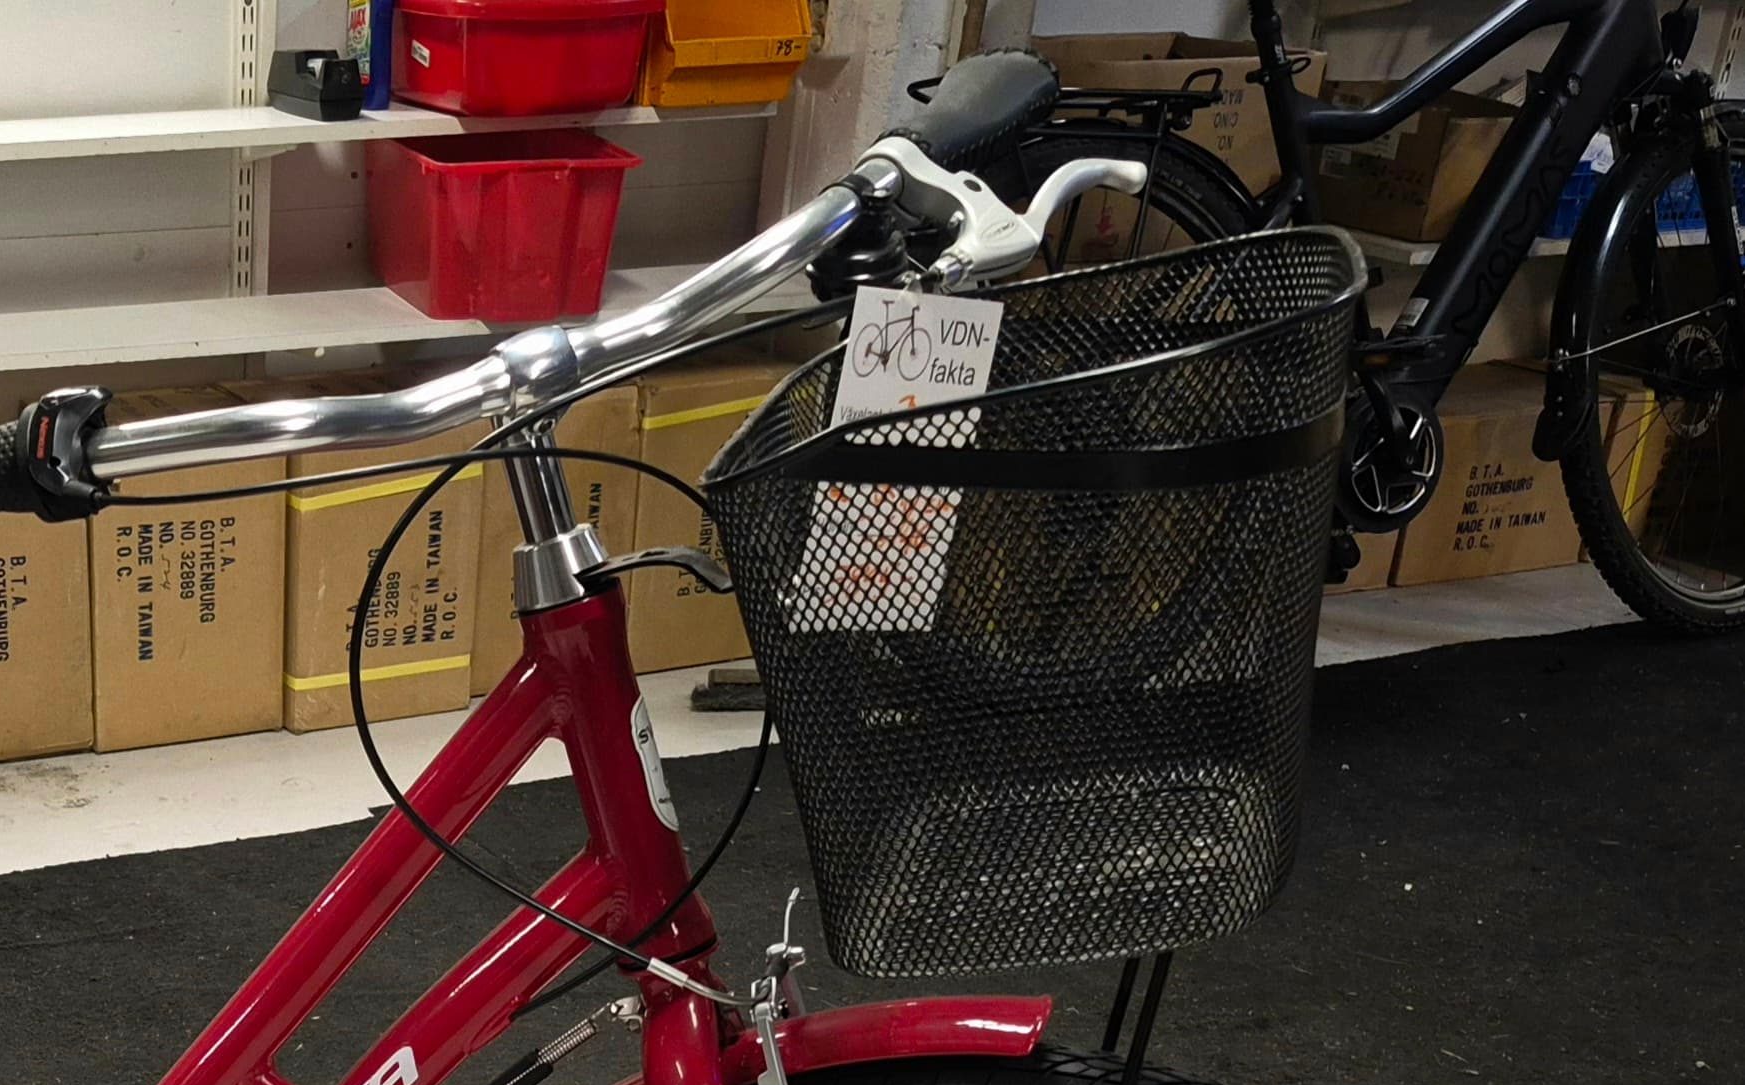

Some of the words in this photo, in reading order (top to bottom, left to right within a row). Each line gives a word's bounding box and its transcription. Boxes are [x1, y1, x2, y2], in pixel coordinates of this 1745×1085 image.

[940, 318, 990, 348] VDN-
[928, 357, 976, 386] fakta
[588, 482, 602, 530] AIWAN
[1465, 476, 1534, 498] GOTHENBURG
[159, 521, 174, 549] NO.
[427, 510, 443, 569] TAIWAN
[1456, 518, 1484, 535] MADE
[1489, 516, 1502, 531] IN
[1508, 511, 1546, 529] TAIWAN
[138, 524, 153, 566] MADE
[137, 575, 153, 593] IN
[180, 551, 196, 600] 32889
[199, 519, 216, 623] GOTHENBURG
[426, 578, 440, 594] IN
[385, 571, 401, 618] 32889
[138, 602, 153, 661] TAIWAN
[422, 604, 438, 643] MADE
